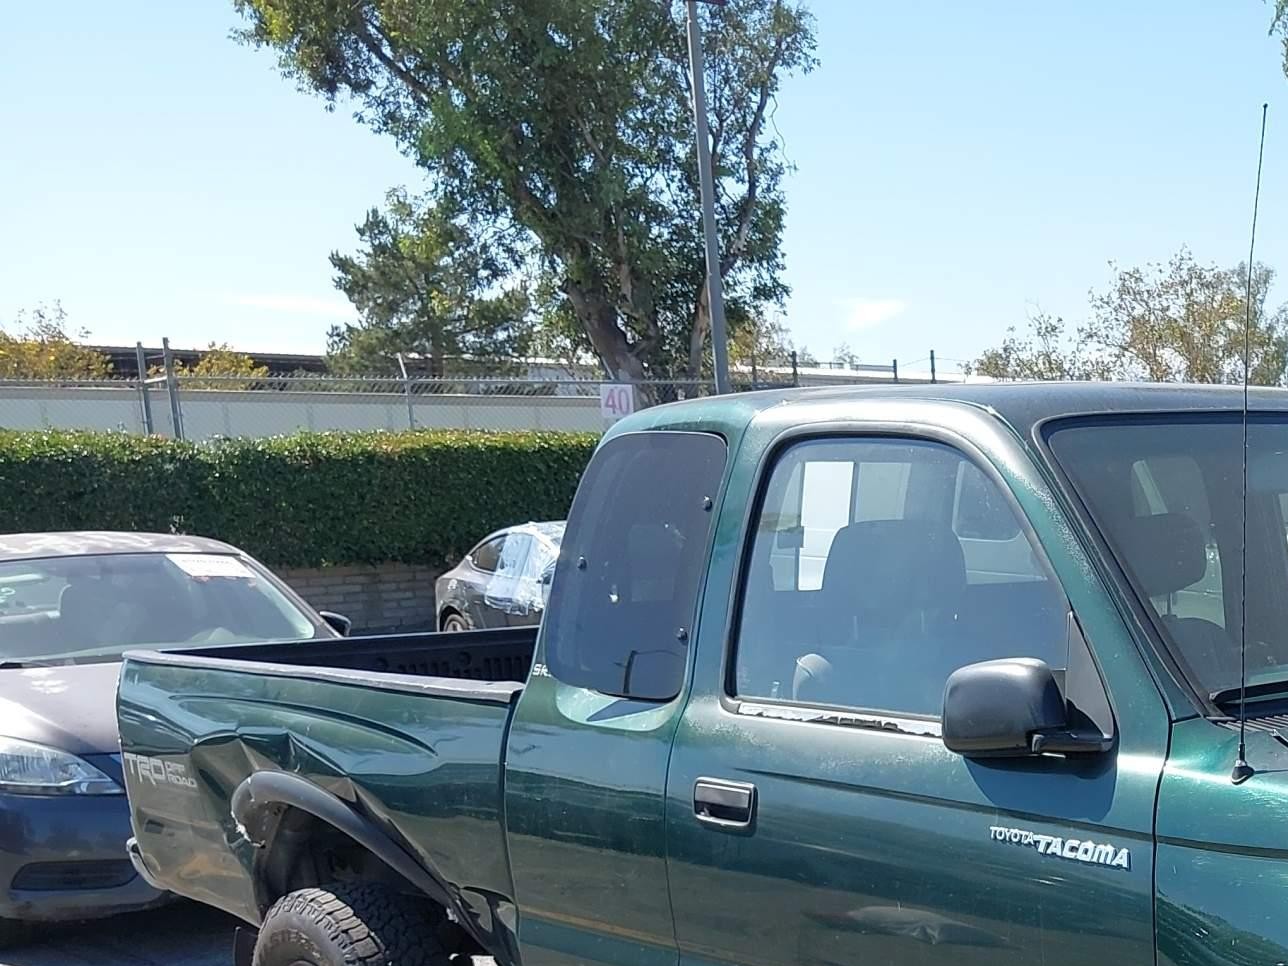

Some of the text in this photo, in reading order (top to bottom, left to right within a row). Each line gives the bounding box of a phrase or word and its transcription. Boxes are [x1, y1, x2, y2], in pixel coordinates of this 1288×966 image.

[605, 388, 630, 415] 40
[532, 663, 551, 676] SR
[124, 752, 166, 786] TRD
[990, 826, 1131, 868] TOYOTA TACOMA
